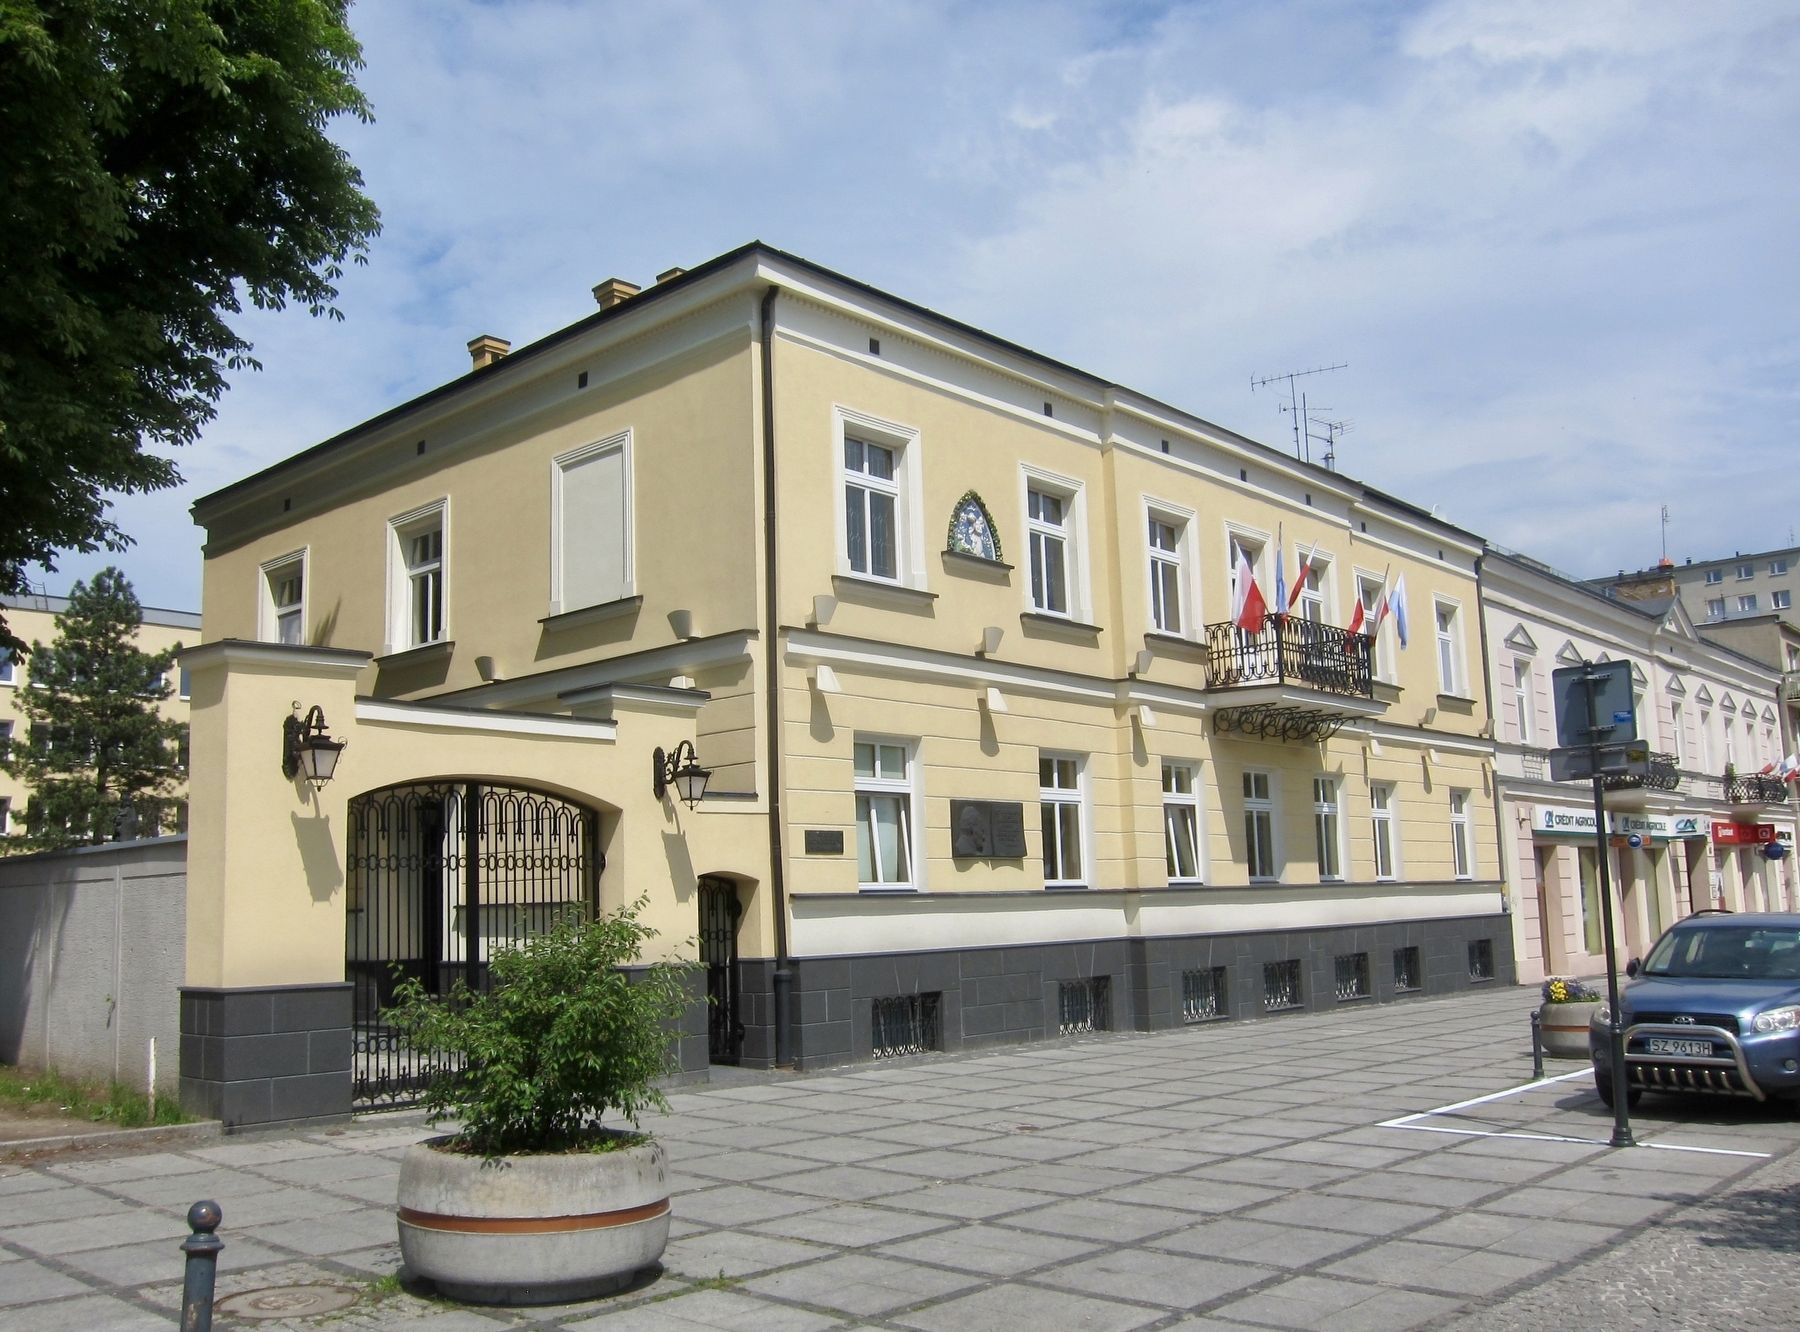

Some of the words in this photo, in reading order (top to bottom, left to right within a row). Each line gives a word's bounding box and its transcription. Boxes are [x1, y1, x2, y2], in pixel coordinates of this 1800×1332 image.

[1575, 816, 1598, 827] AGRICOL
[1652, 1039, 1669, 1051] SZ
[1672, 1041, 1710, 1055] 9613H
